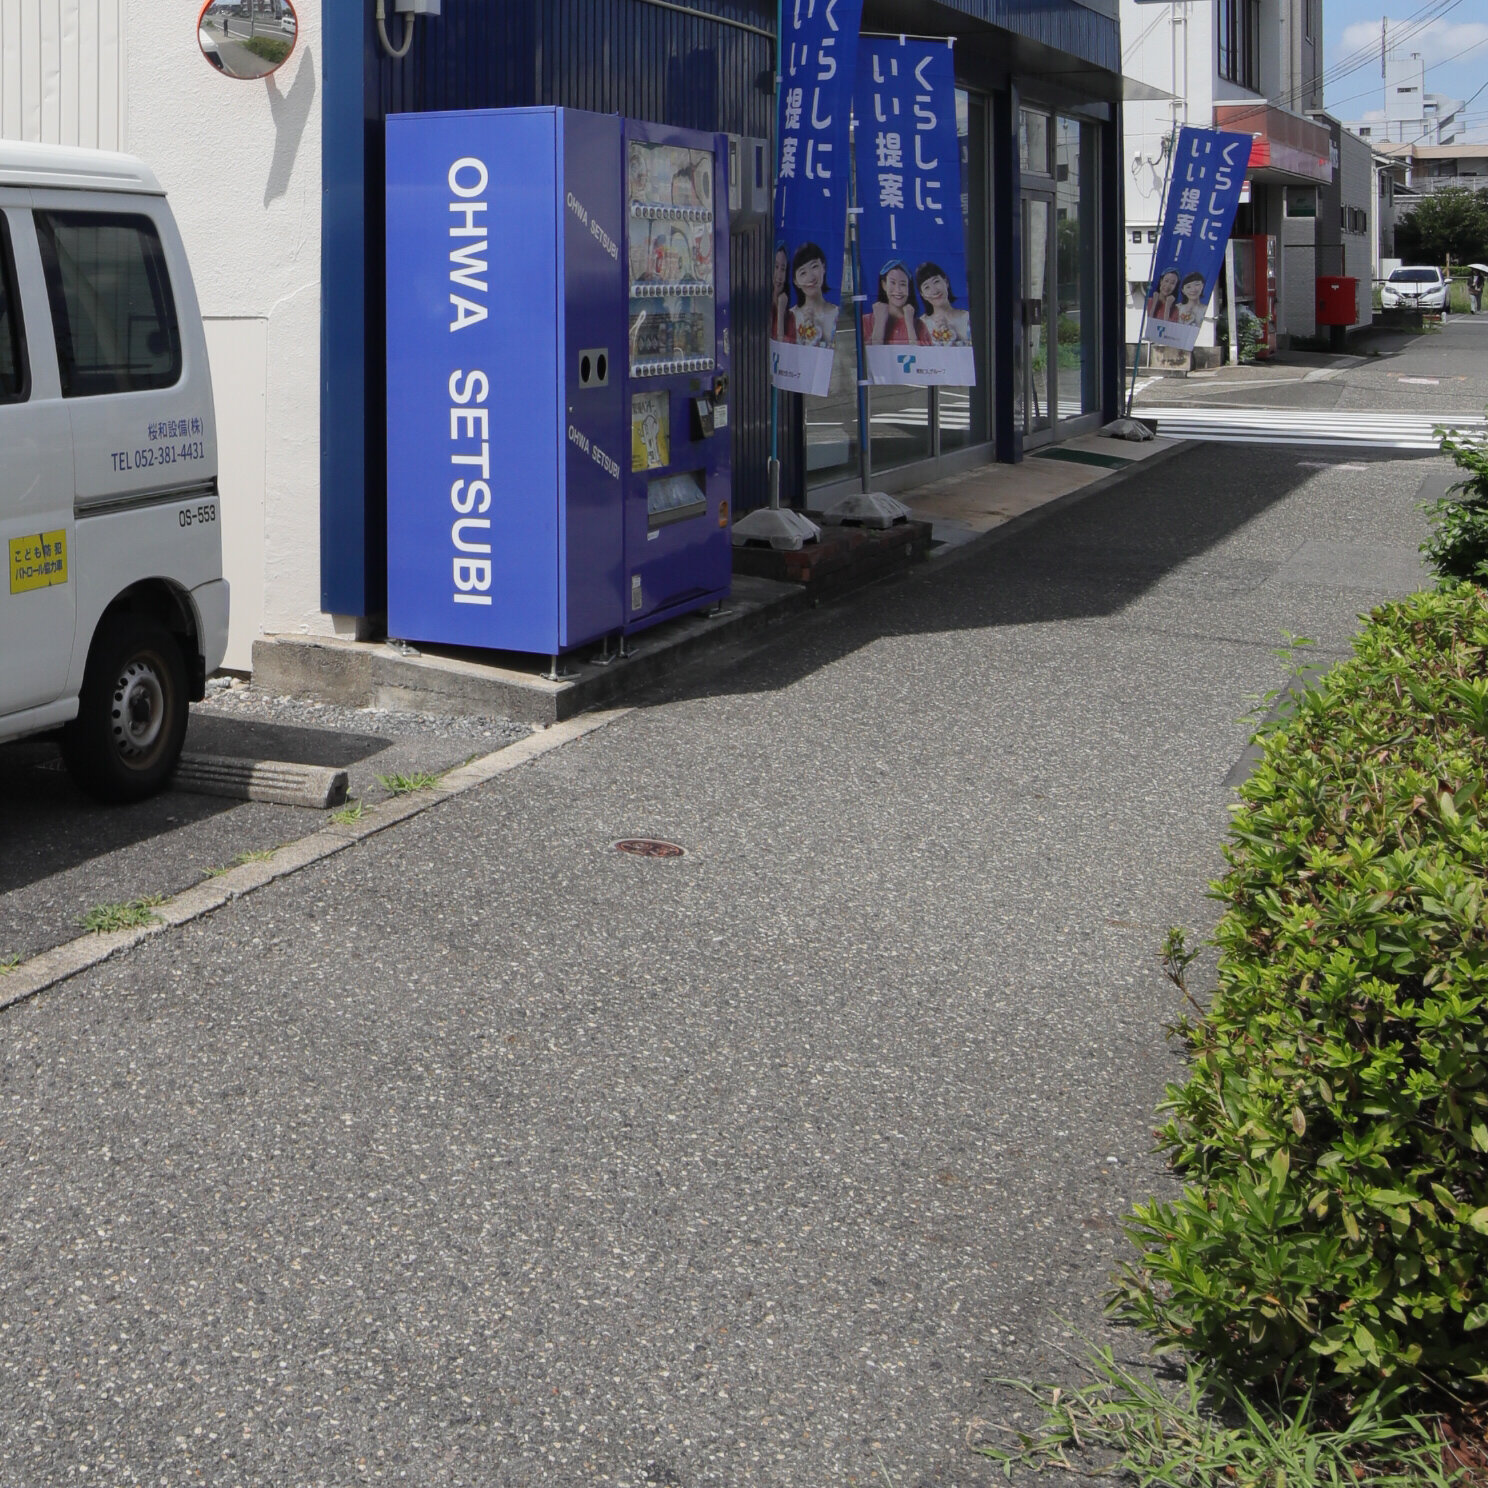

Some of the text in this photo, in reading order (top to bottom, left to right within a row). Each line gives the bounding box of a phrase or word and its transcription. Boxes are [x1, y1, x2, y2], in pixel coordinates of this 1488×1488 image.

[914, 56, 945, 225] くらしに、
[567, 192, 619, 261] OHWA SETSUBI
[448, 156, 492, 606] OHWA SETSUBI
[111, 442, 205, 472] TEL 052-381-4431
[148, 417, 204, 441] 桜和設備(株)
[568, 424, 590, 455] OHWA
[592, 445, 620, 480] SETSUBI
[178, 505, 216, 528] OS-553
